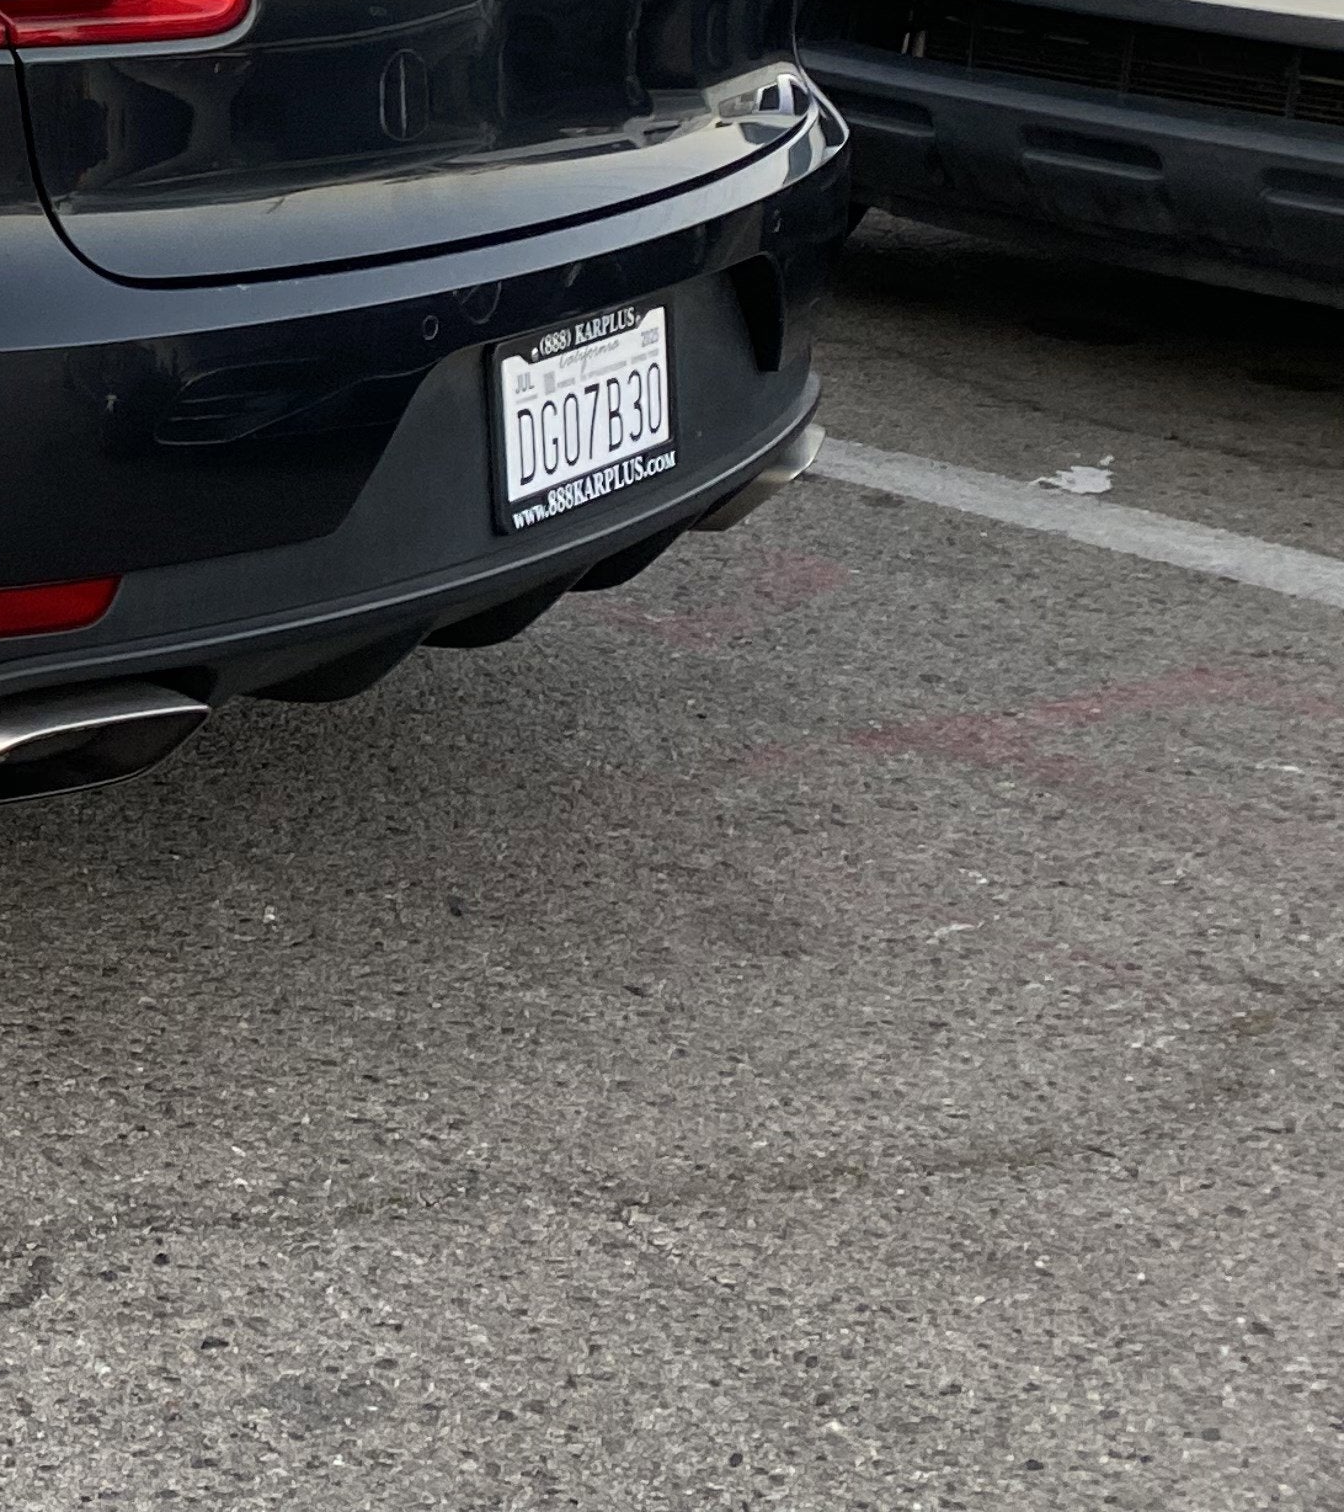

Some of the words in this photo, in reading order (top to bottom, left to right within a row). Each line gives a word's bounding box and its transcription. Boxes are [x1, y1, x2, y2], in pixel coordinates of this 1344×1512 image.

[539, 328, 572, 356] (888)
[574, 306, 635, 346] KARPLUS
[516, 361, 663, 486] DG07B30
